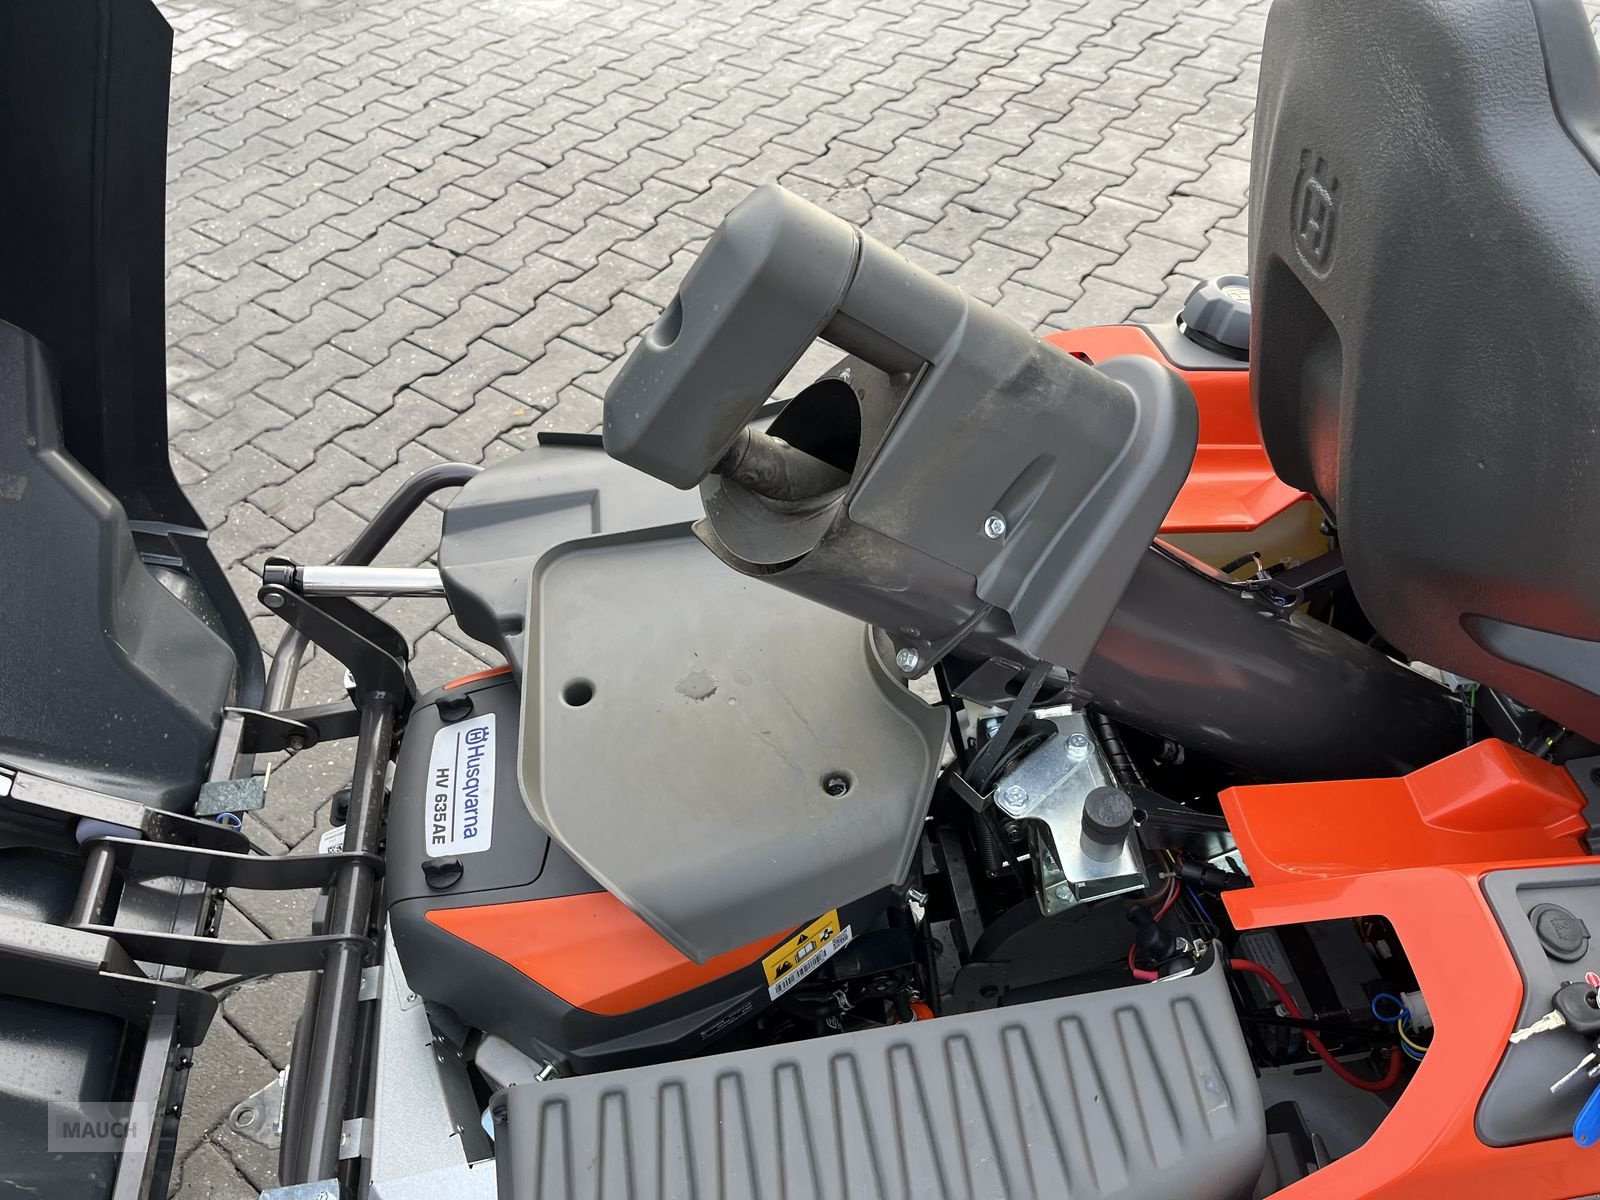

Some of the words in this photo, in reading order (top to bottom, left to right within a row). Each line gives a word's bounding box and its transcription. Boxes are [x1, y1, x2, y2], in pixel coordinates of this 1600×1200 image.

[435, 768, 449, 788] HV
[462, 745, 485, 839] Husqvarna
[432, 794, 448, 845] 635AE
